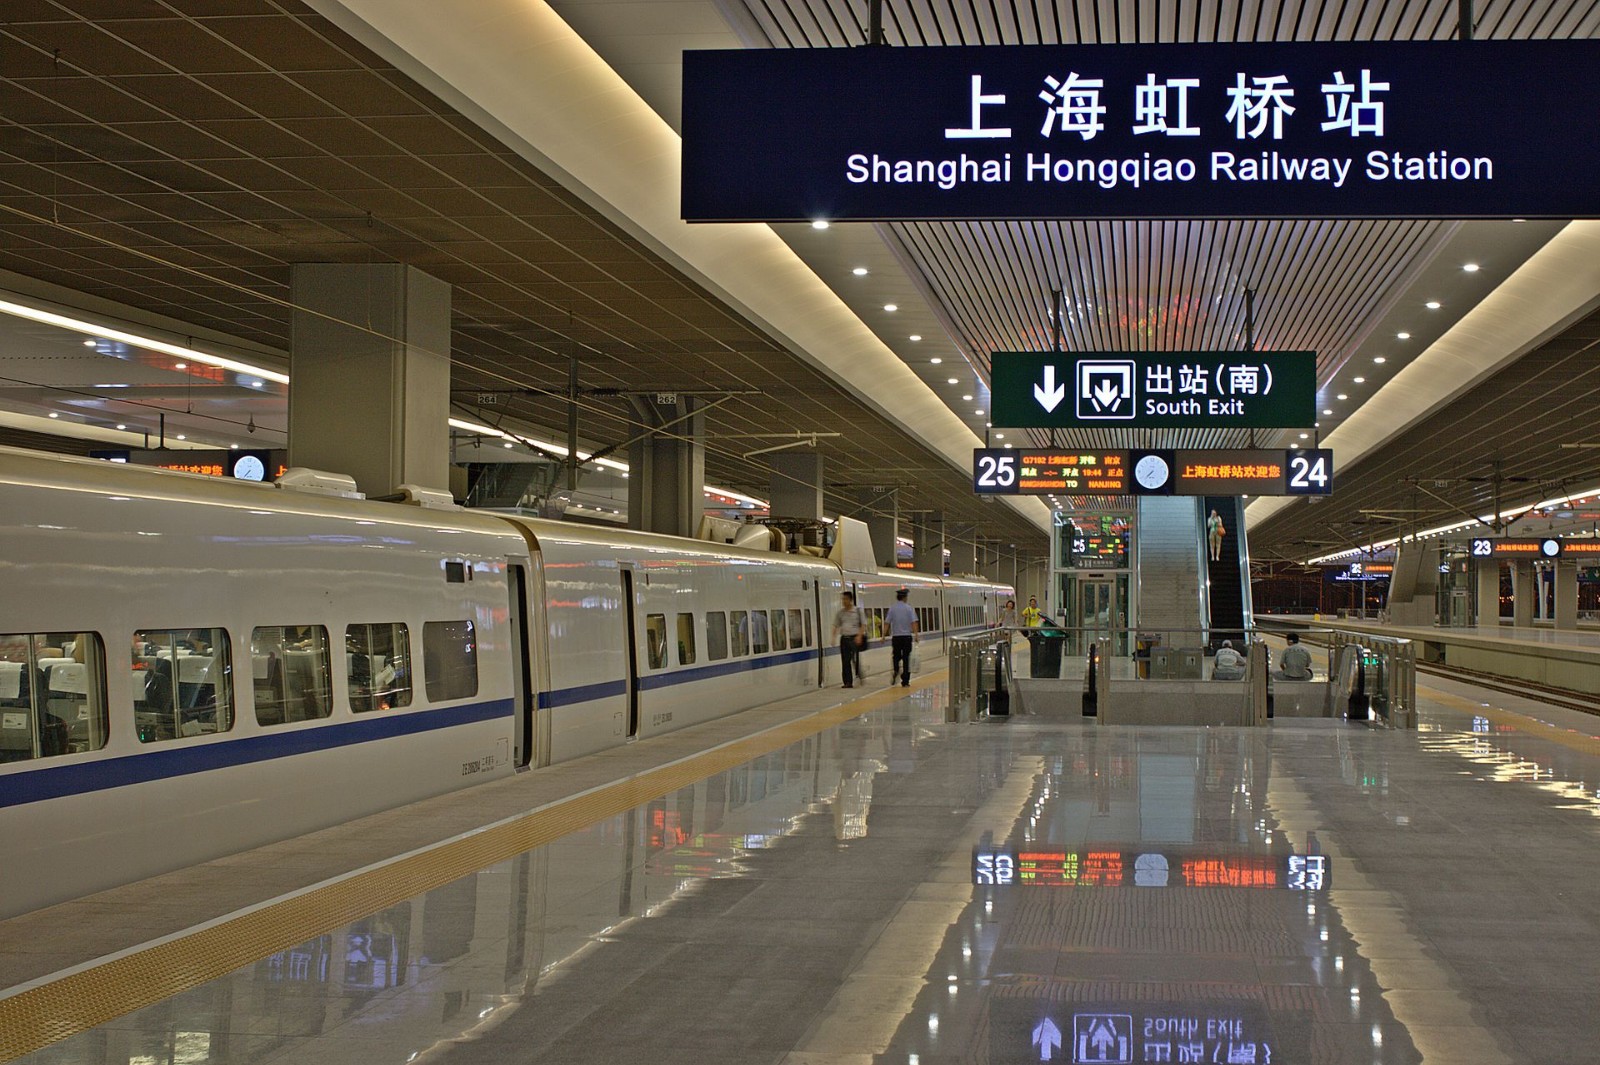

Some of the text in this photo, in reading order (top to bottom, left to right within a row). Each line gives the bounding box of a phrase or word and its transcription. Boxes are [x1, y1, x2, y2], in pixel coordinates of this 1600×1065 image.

[944, 69, 1390, 141] 上海虹桥站
[846, 150, 1493, 190] Shanghai Hongqiao Railway Station
[1145, 398, 1245, 415] South Exit
[978, 456, 1015, 487] 25
[1182, 465, 1281, 478] 上海虹桥站欢迎您
[1290, 457, 1328, 487] 24
[1088, 480, 1122, 489] NANJING
[1473, 540, 1492, 556] 23
